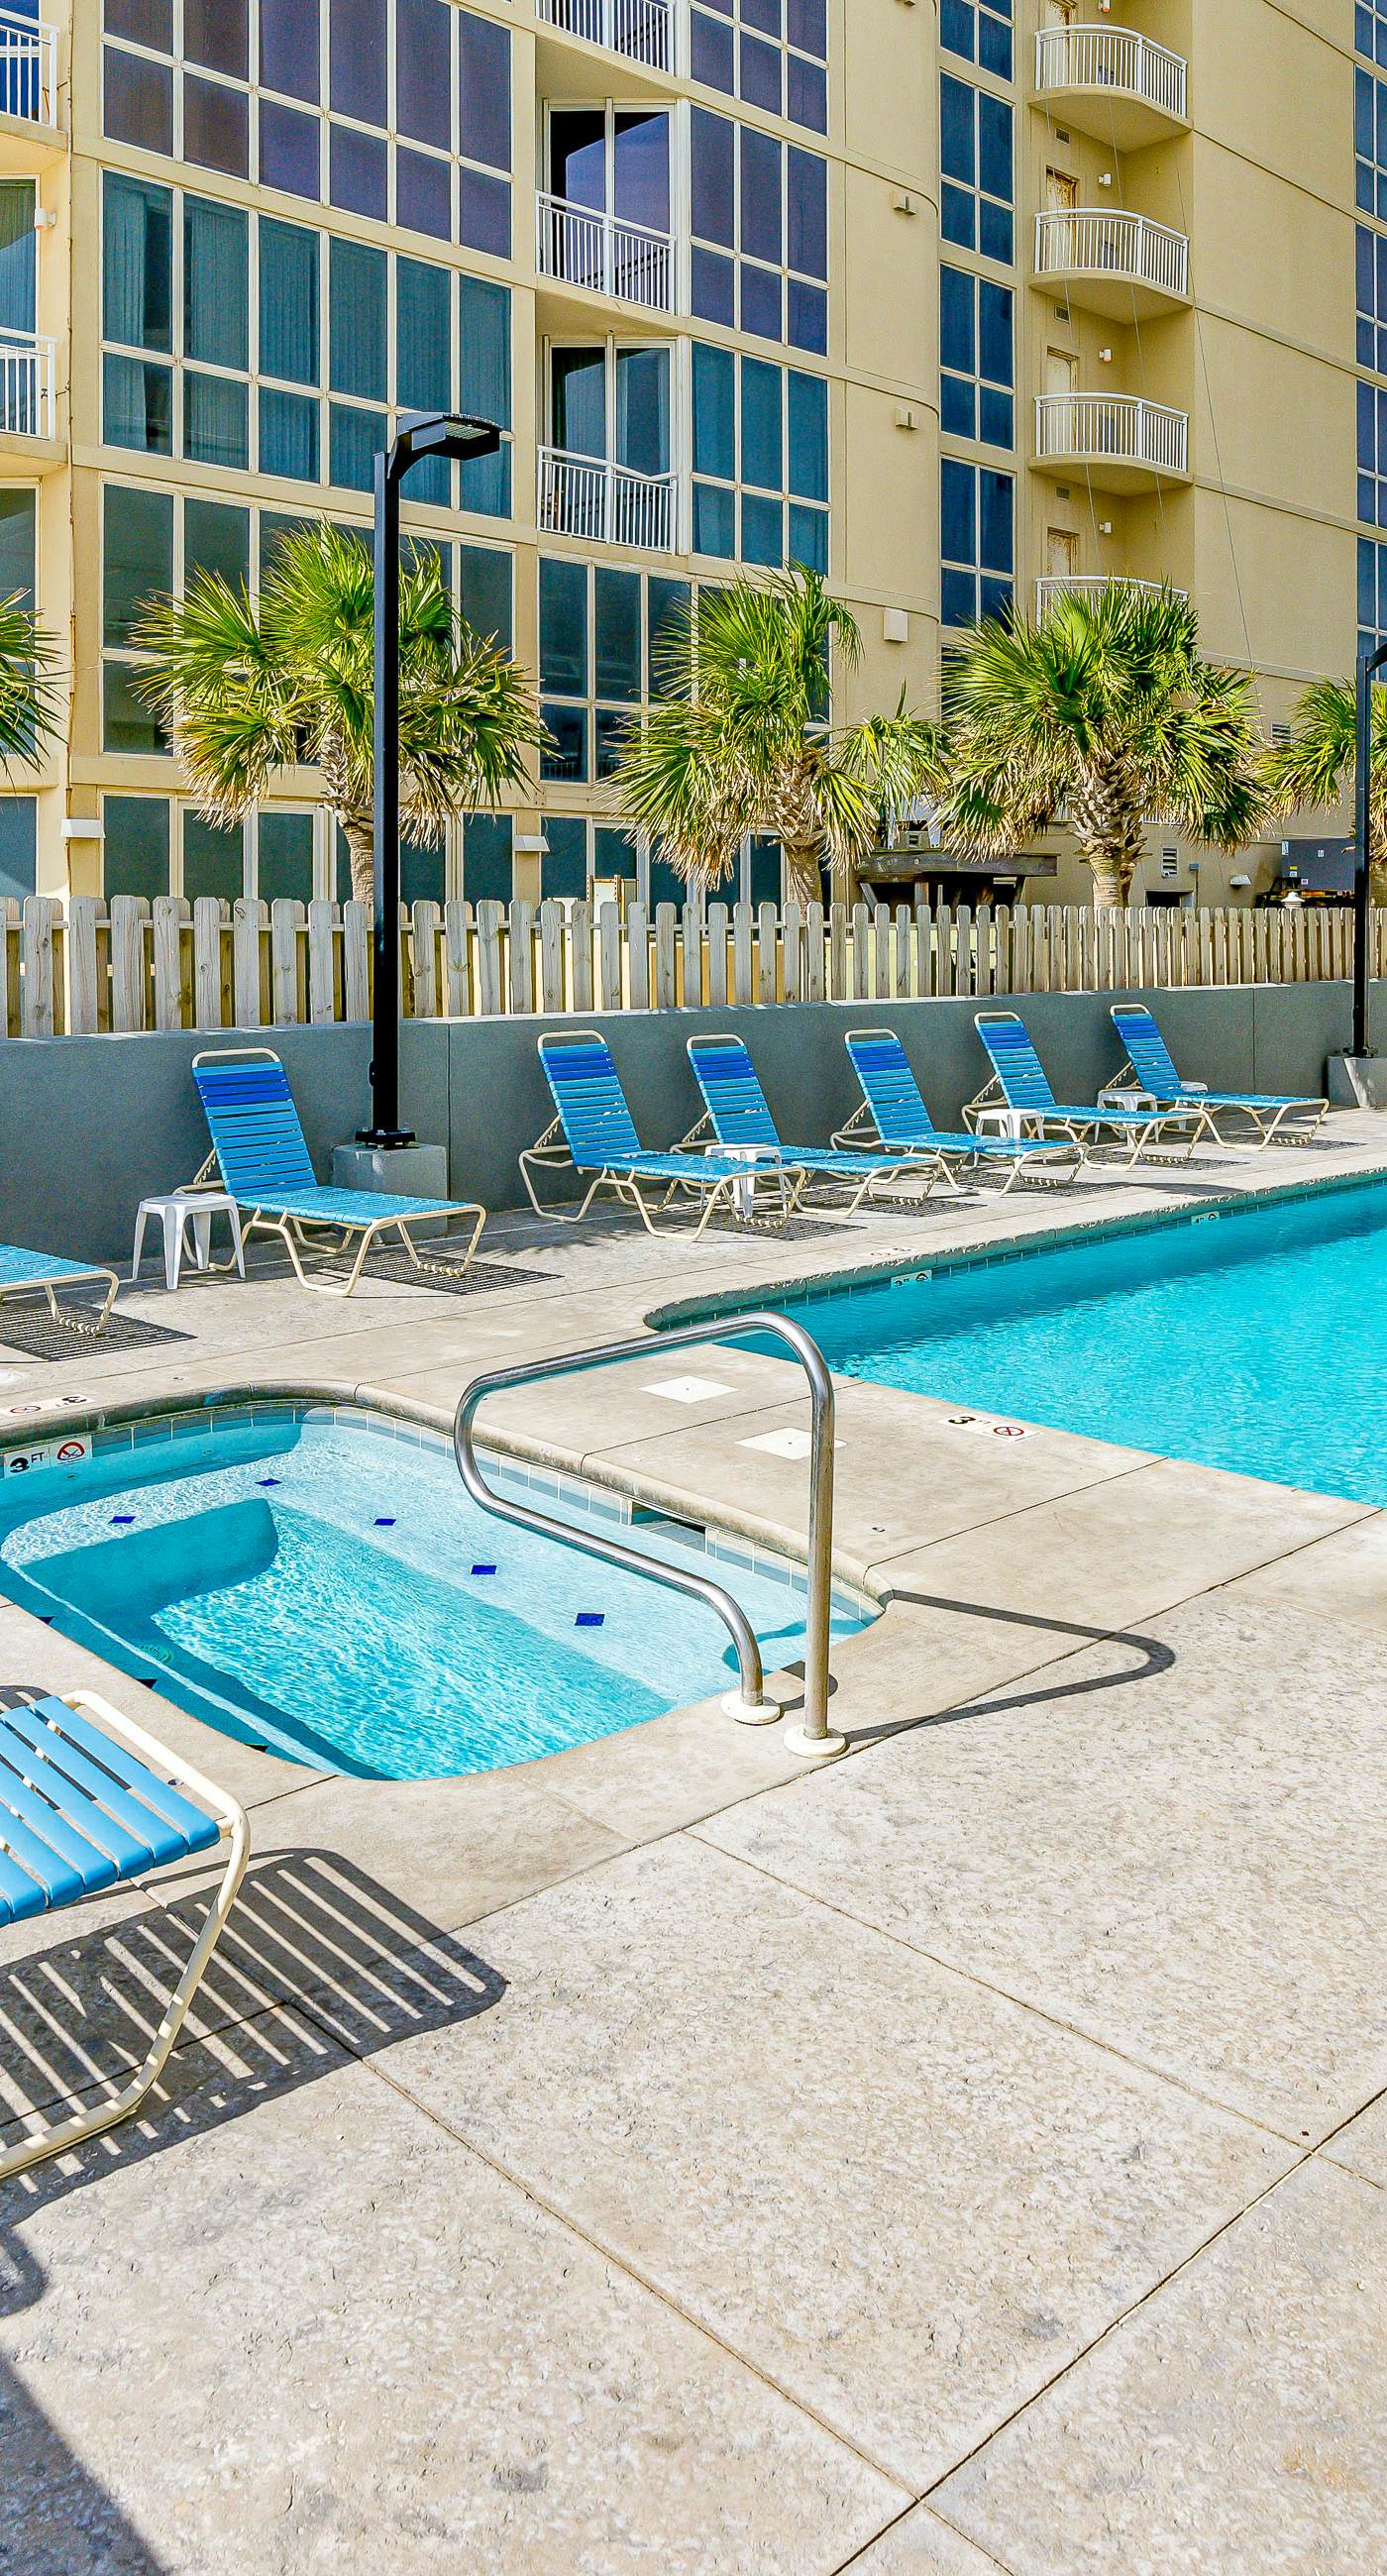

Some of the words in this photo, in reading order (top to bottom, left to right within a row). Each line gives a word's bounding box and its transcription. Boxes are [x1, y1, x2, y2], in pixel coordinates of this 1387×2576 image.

[948, 1416, 976, 1425] 3
[10, 1456, 30, 1473] 3
[31, 1451, 45, 1463] FT
